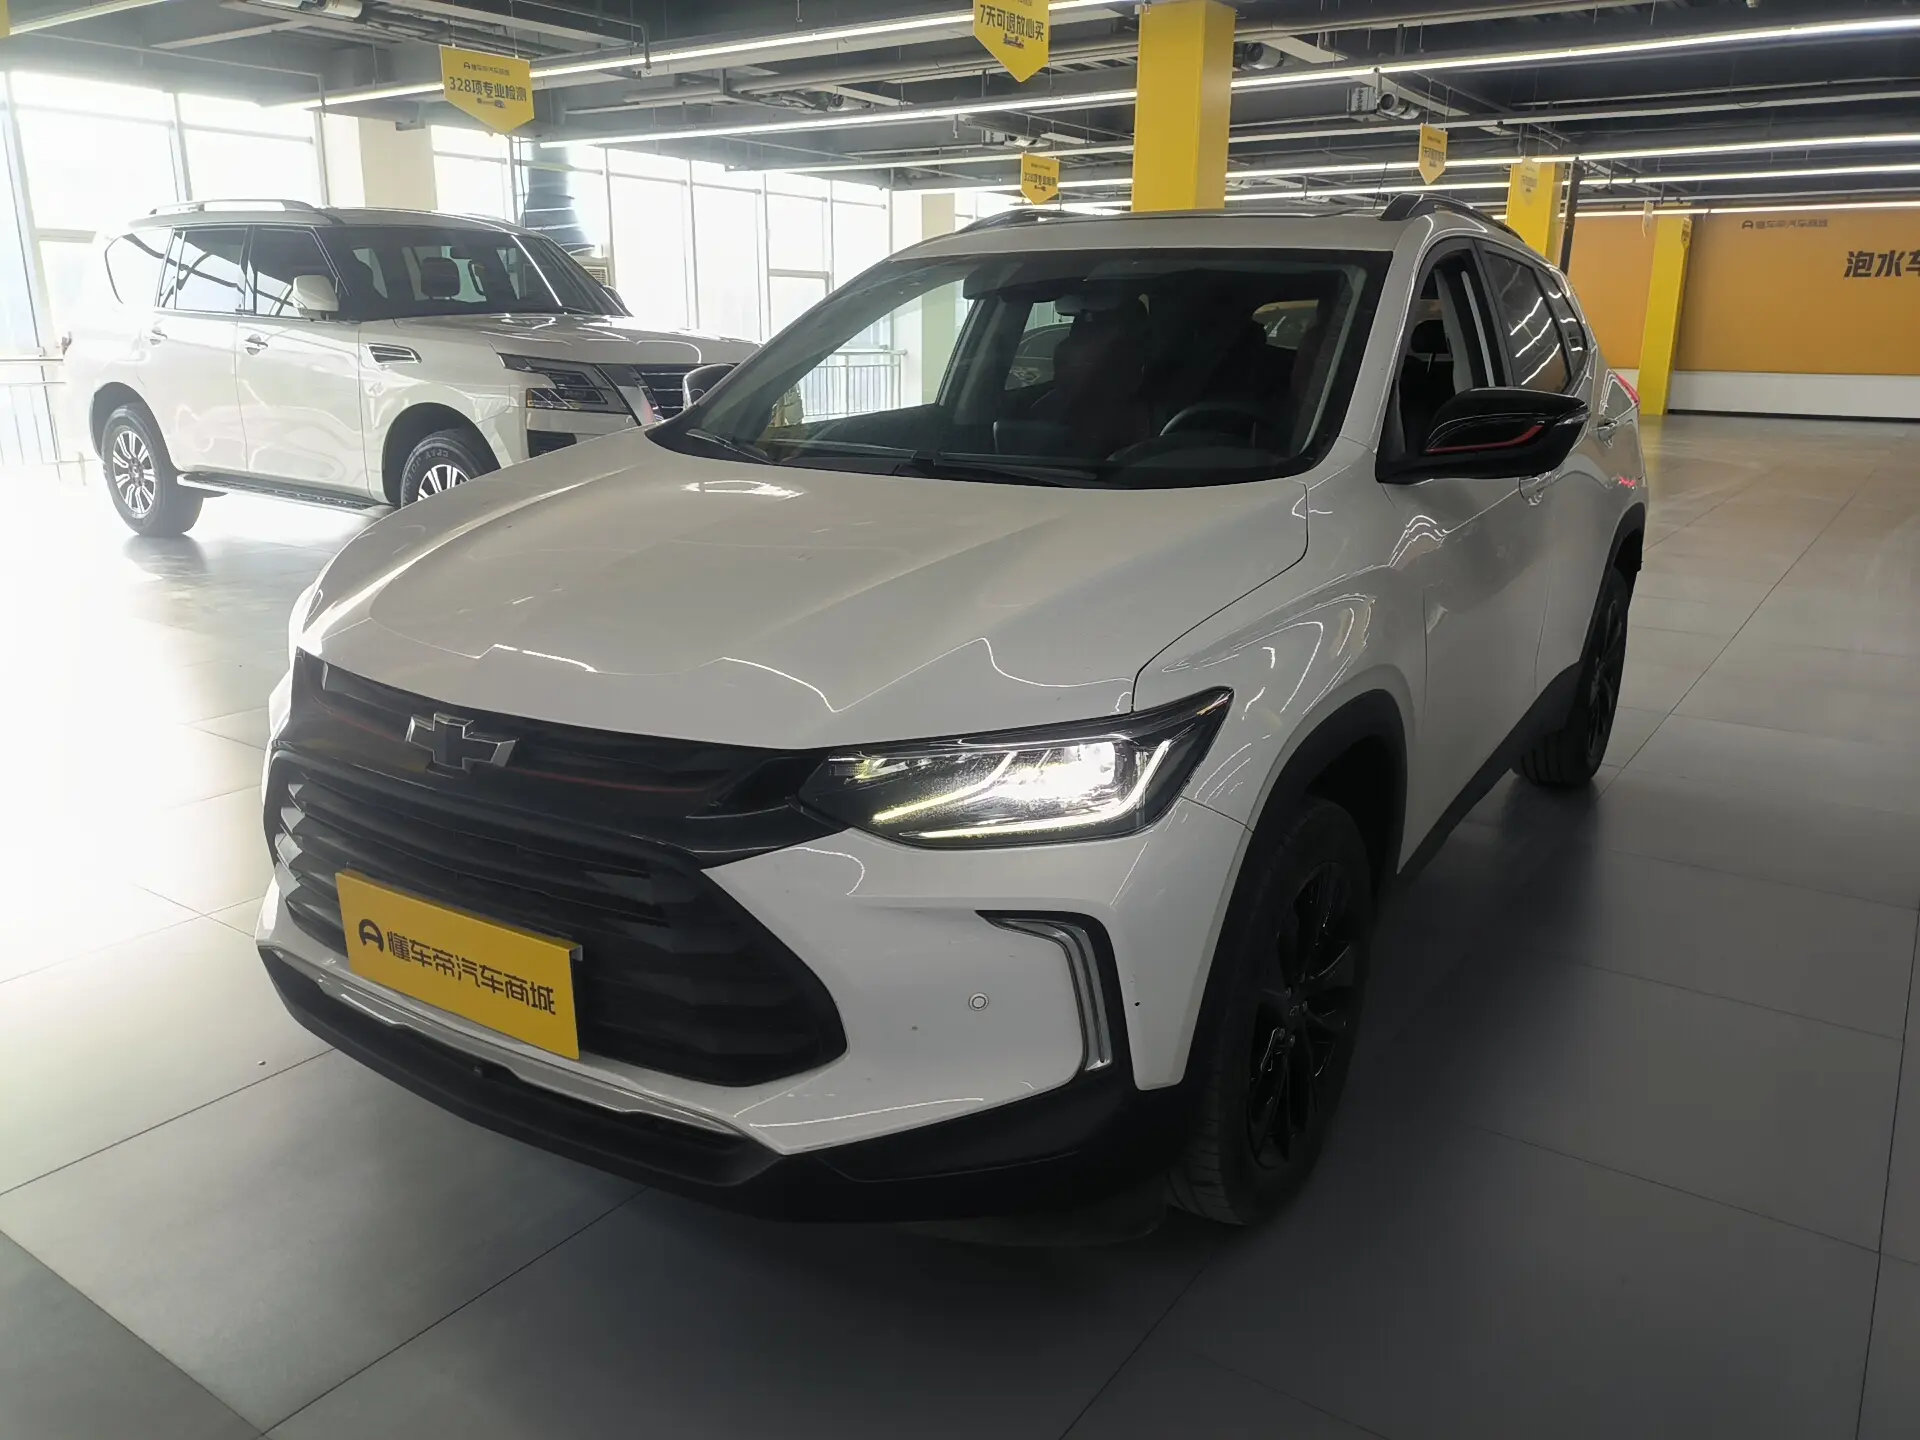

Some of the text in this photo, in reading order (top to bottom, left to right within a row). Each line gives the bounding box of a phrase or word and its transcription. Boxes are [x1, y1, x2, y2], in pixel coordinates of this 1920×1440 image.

[980, 4, 1044, 42] 7天可退放心买
[449, 77, 526, 102] 328项专业检测
[387, 931, 556, 1015] 懂车帝汽车商城
